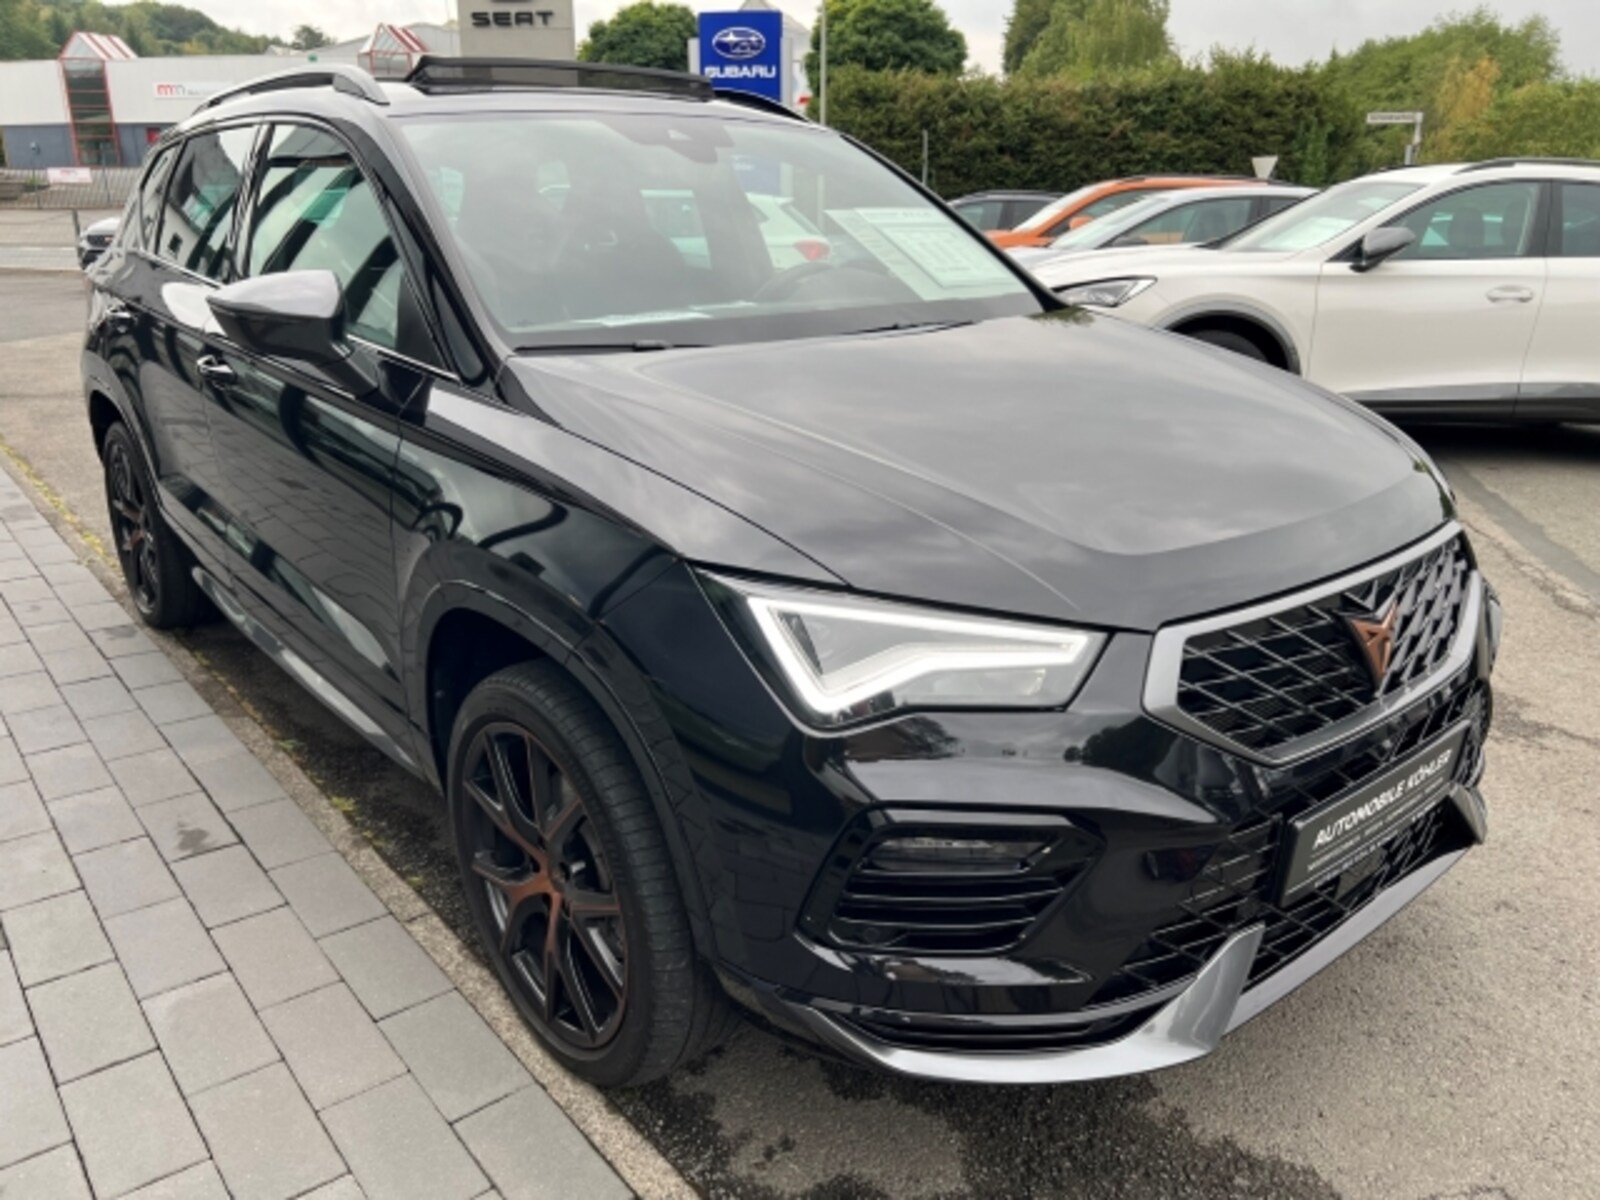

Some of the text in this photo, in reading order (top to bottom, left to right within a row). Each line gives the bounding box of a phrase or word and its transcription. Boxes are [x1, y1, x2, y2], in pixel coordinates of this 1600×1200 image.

[471, 11, 554, 27] SEAT
[704, 65, 776, 79] SUBARU
[1312, 779, 1406, 850] AUTOMOBILE
